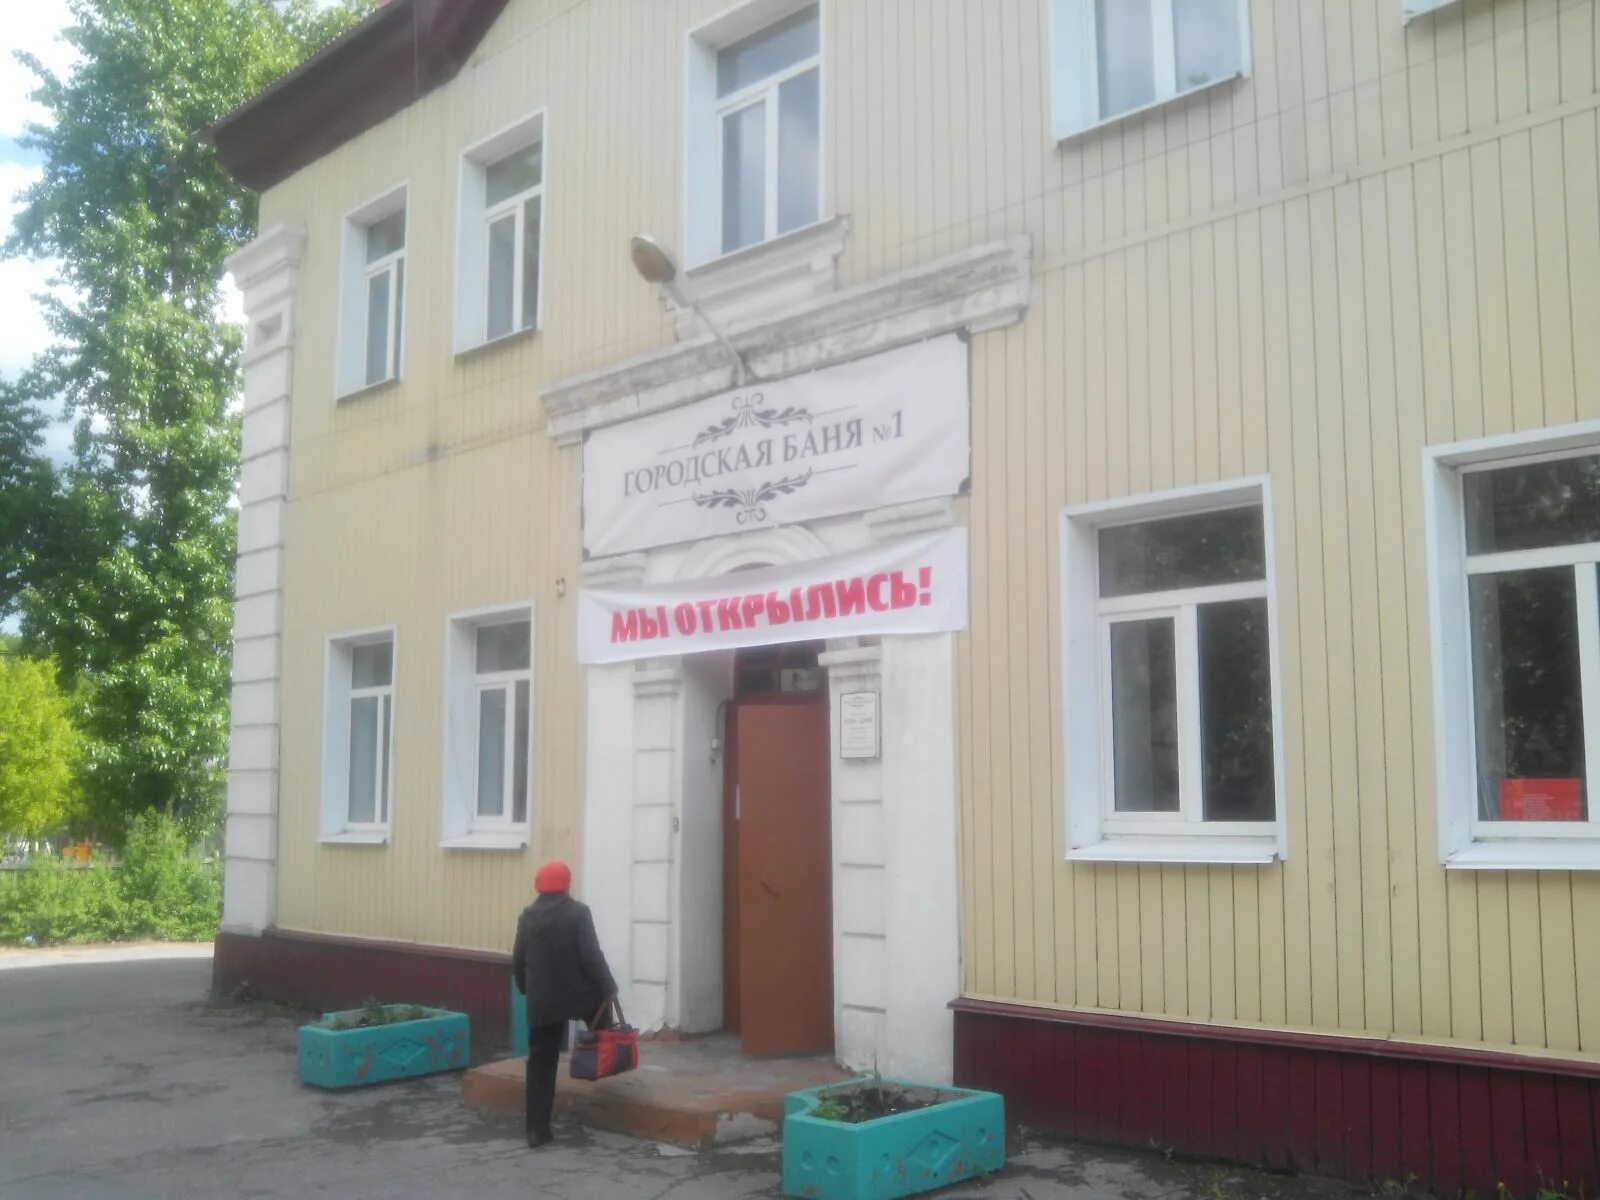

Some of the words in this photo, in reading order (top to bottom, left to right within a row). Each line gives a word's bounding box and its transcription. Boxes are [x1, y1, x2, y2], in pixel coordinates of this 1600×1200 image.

[623, 438, 773, 497] ГОРОДСКАЯ
[783, 418, 863, 462] БАНЯ
[611, 605, 669, 643] МЫ
[674, 566, 932, 636] ОТКРЫЛИСЬ!
